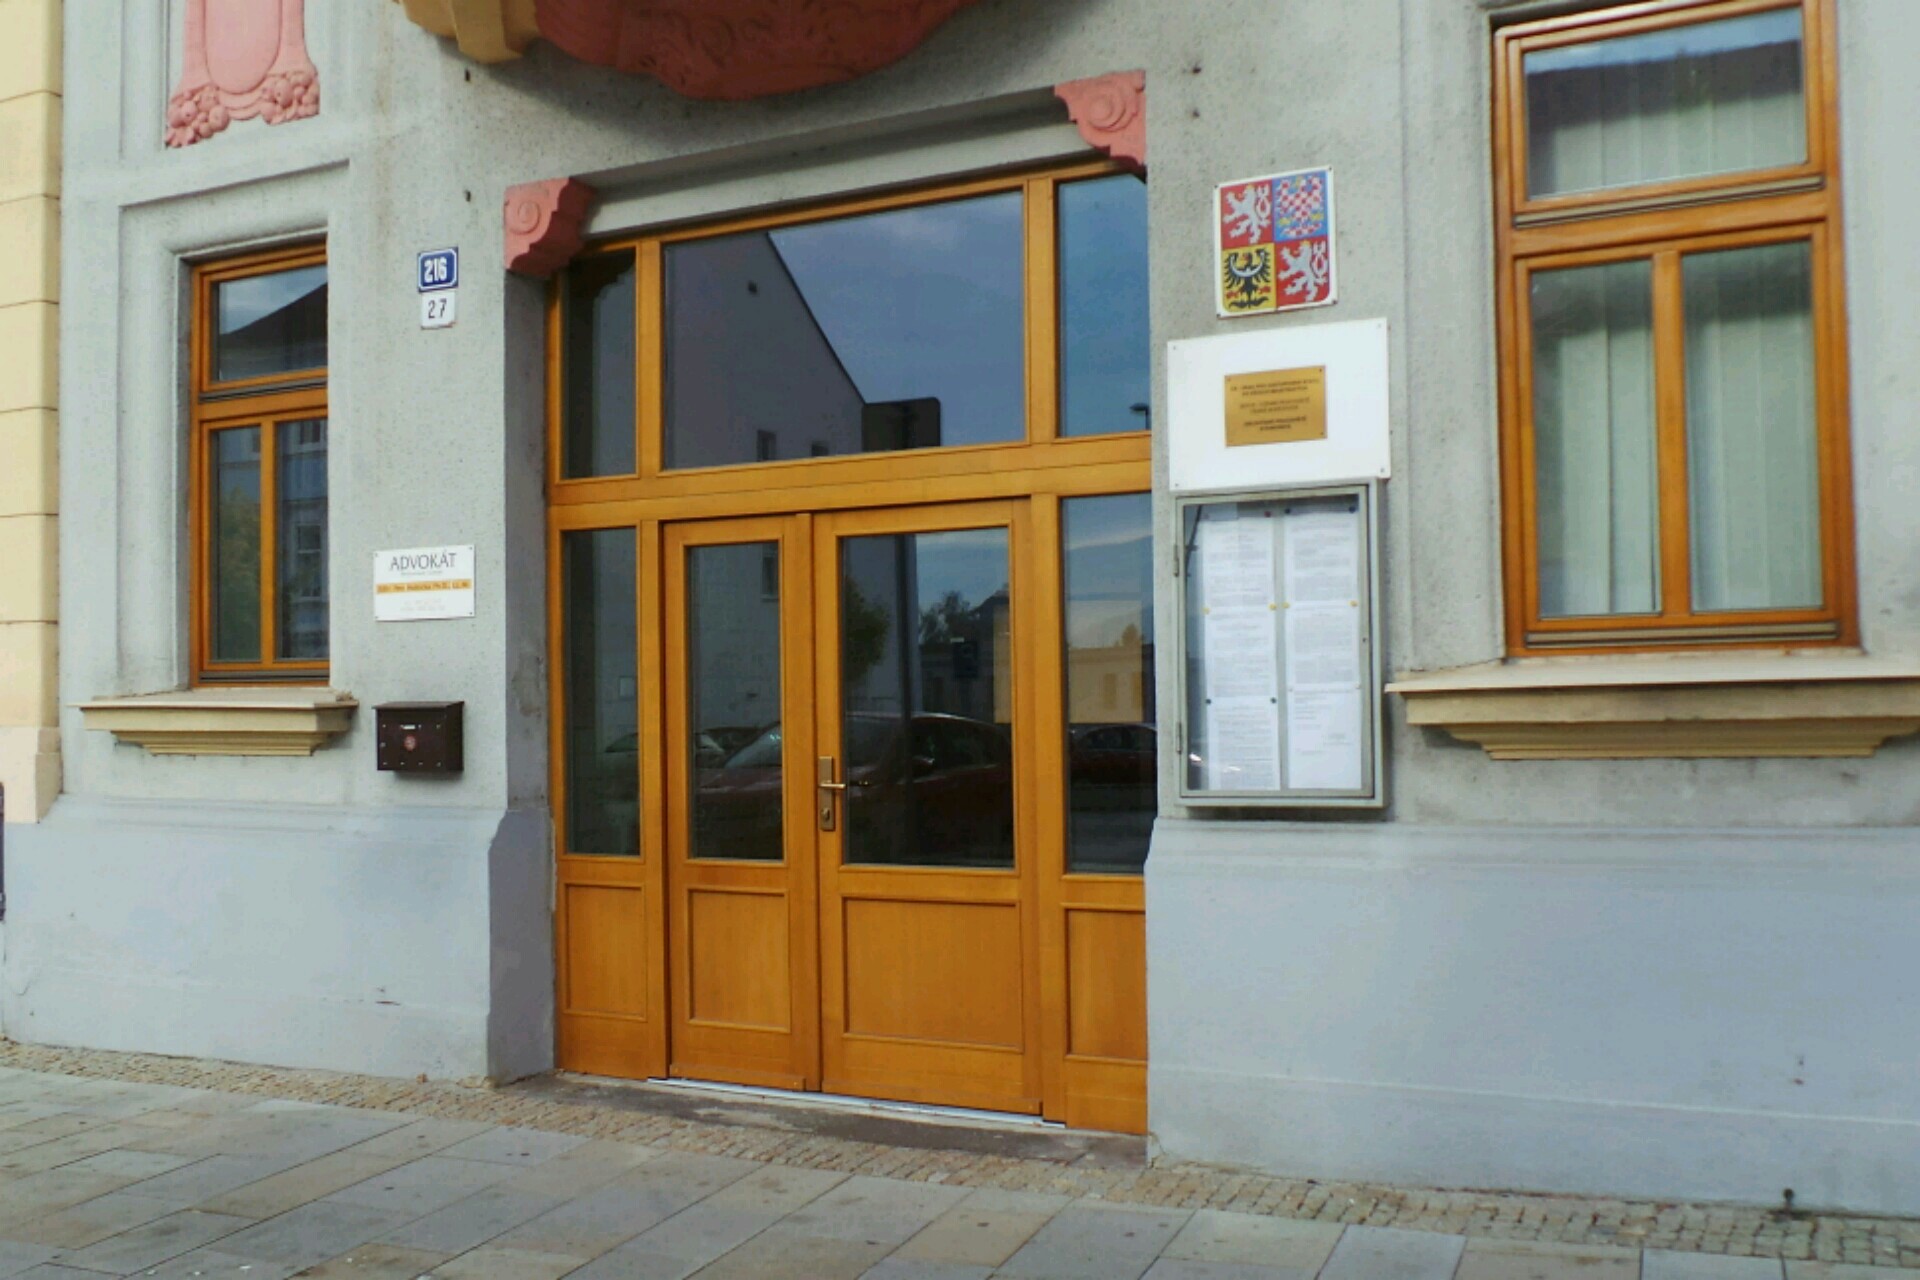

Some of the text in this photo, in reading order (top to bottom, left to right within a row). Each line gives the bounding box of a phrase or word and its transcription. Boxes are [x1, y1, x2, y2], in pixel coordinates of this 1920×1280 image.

[424, 257, 447, 283] 216
[428, 298, 447, 319] 27
[390, 550, 457, 571] ADVOKÁT
